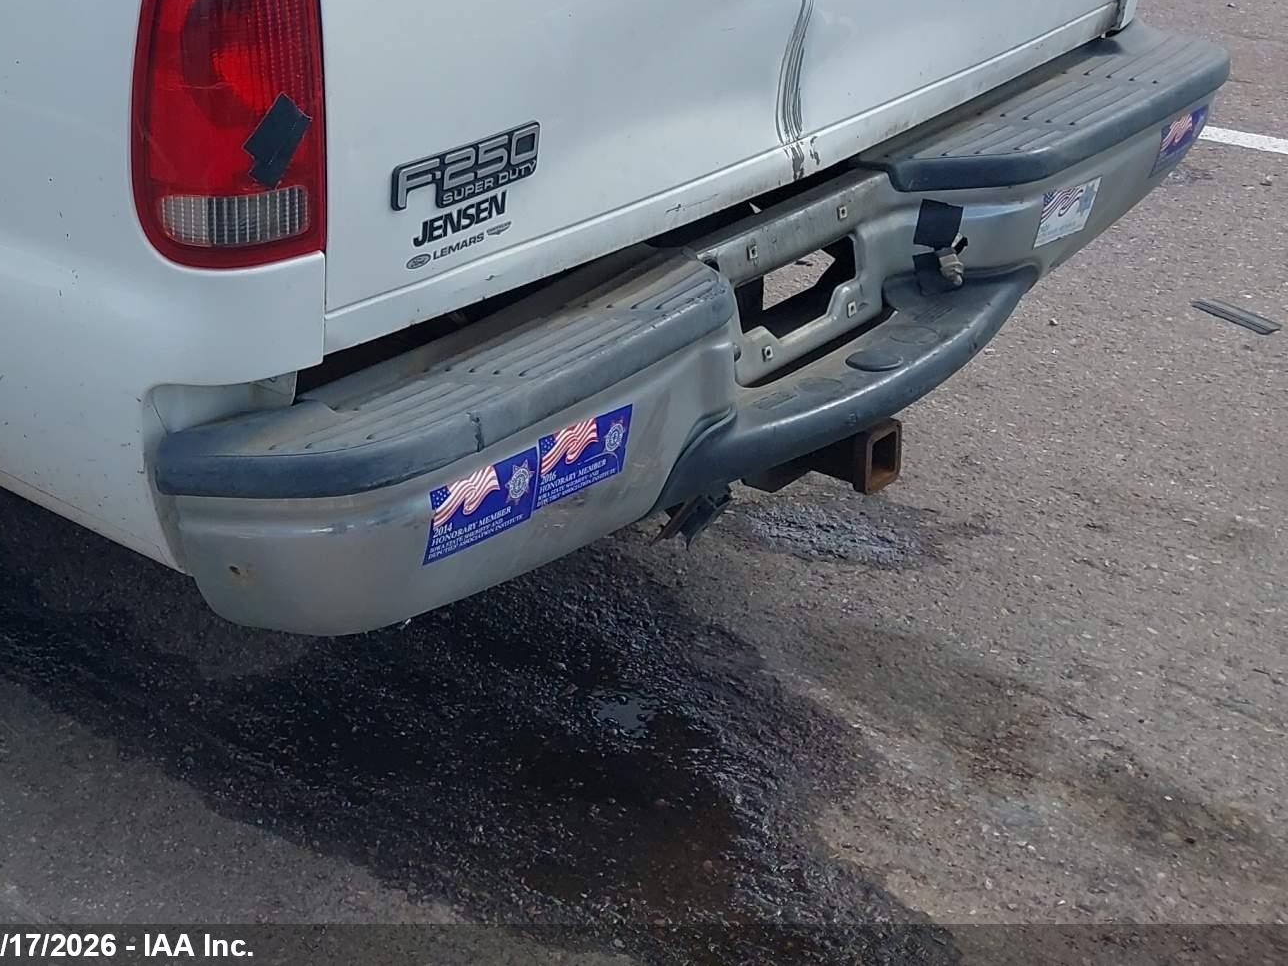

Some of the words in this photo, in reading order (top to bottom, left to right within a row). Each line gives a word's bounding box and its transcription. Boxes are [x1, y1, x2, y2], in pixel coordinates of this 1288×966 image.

[442, 179, 494, 204] SUPER
[497, 159, 537, 183] DUTY
[413, 189, 507, 247] JENSEN
[433, 231, 485, 260] LEMARS
[539, 472, 576, 494] HONORARY
[578, 458, 607, 476] MEMBER
[431, 521, 477, 547] HONORARY
[478, 505, 512, 527] MEMBER
[432, 521, 453, 538] 2014
